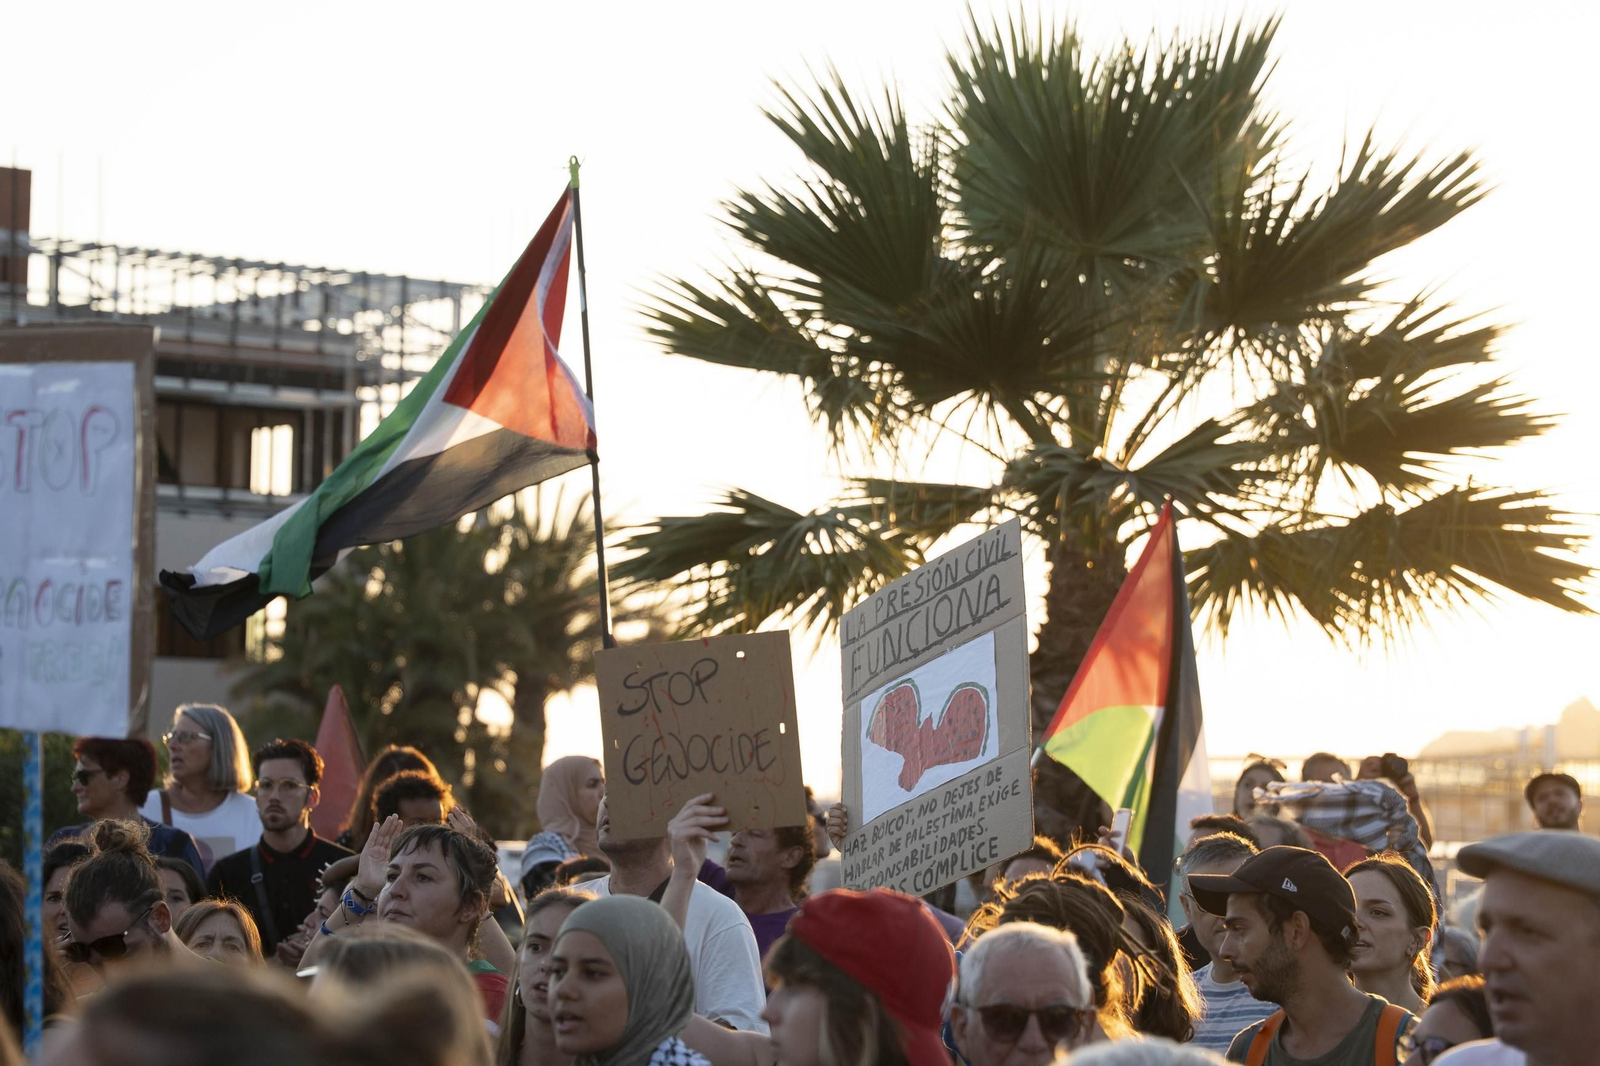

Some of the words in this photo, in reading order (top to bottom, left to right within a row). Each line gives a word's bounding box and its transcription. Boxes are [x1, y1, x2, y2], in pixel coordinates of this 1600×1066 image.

[0, 403, 121, 497] TOP
[845, 612, 866, 643] LA
[874, 557, 959, 624] PRESIÓN
[965, 530, 1012, 575] CIVIL
[851, 573, 1004, 690] FUNCIONA
[617, 658, 718, 716] STOP
[623, 727, 777, 785] GENOCIDE
[843, 833, 867, 860] HAZ
[872, 808, 915, 845] BOICOT,
[917, 799, 937, 818] NO
[943, 775, 982, 810] DEJES
[985, 766, 1002, 787] DE
[844, 849, 885, 884] HABLAR
[888, 837, 901, 857] DE
[978, 779, 1021, 812] EXIGE
[844, 817, 988, 893] SPONSABILIDADES.
[913, 836, 998, 892] CÓMPLICE
